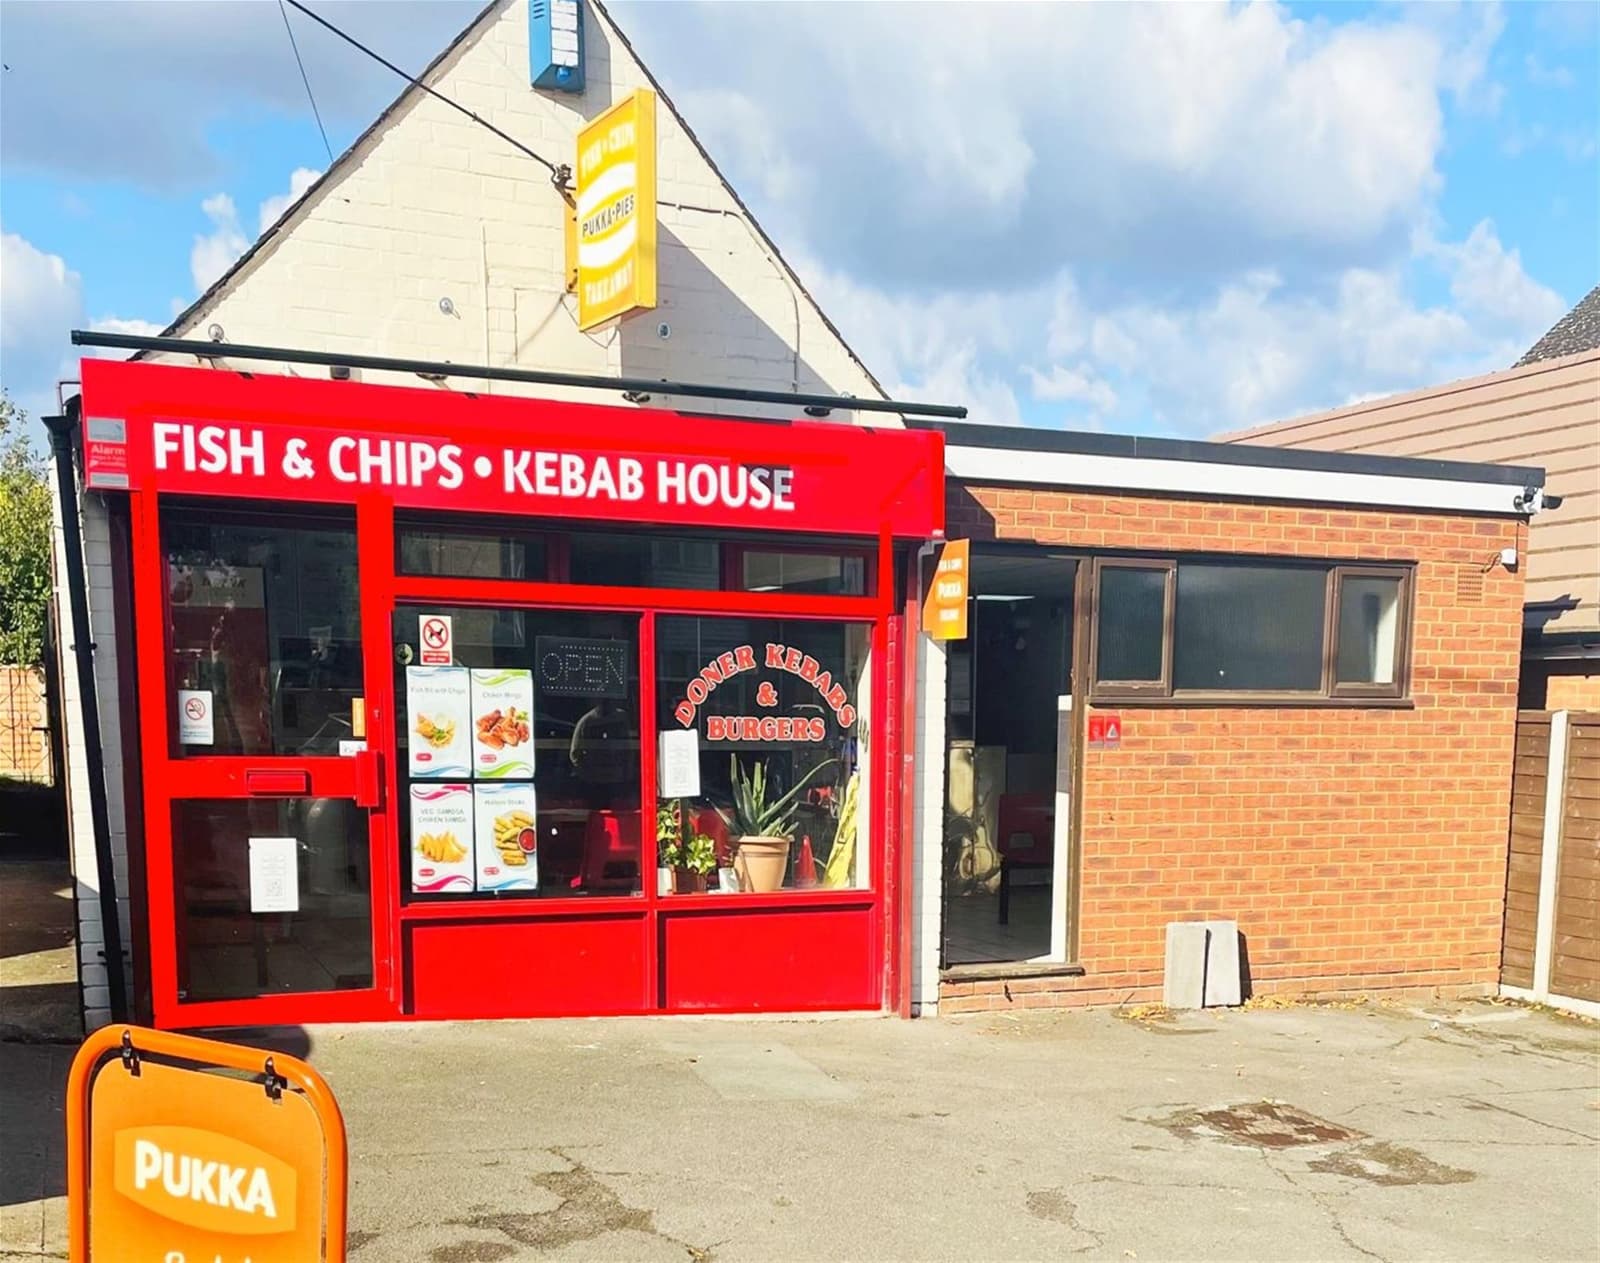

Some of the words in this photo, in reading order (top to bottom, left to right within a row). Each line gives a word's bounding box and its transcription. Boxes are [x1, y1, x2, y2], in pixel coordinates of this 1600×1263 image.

[91, 445, 126, 456] Alarm
[152, 422, 265, 476] FISH
[282, 438, 315, 479] &
[328, 437, 464, 490] CHIPS
[503, 448, 644, 502] KEBAB
[658, 461, 796, 511] HOUSE
[541, 652, 624, 685] OPEN
[674, 645, 756, 728] DONER
[764, 642, 857, 728] KEBABS
[756, 681, 779, 707] &
[706, 716, 826, 742] BURGERS
[134, 1139, 277, 1219] PUKKA
